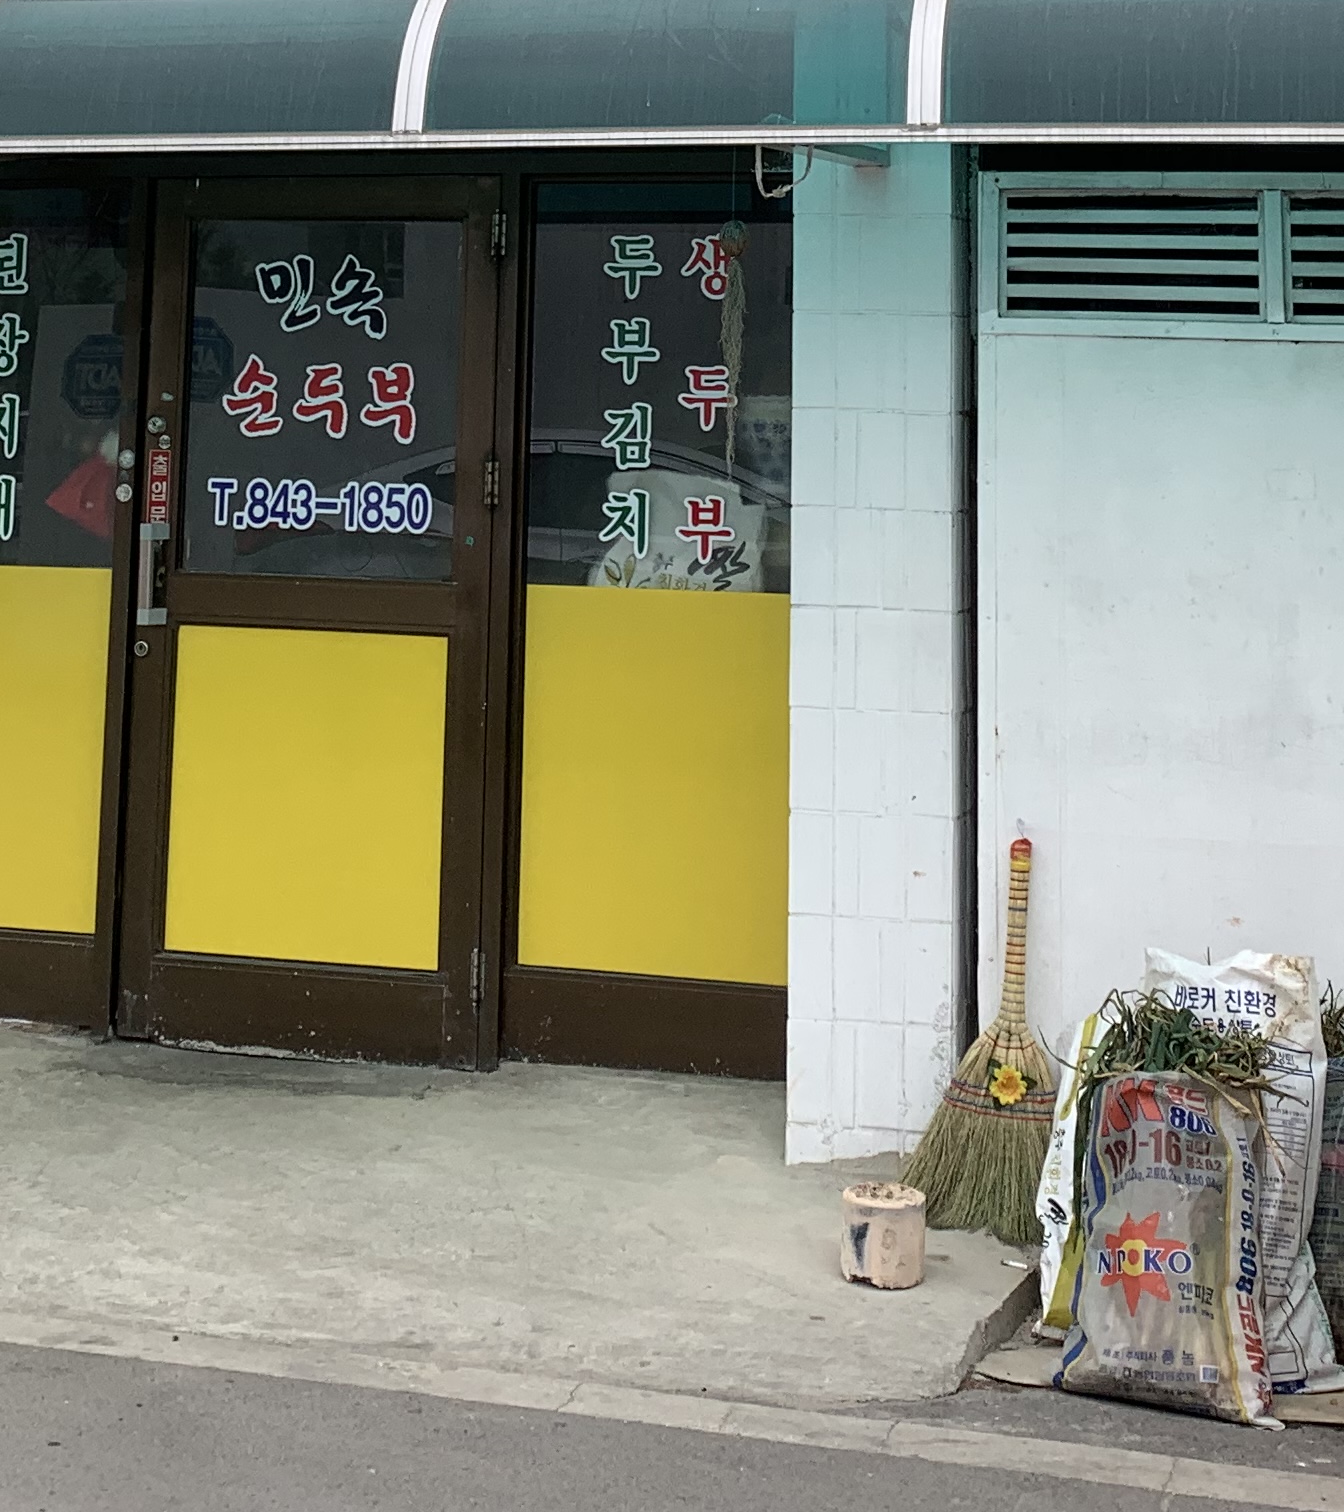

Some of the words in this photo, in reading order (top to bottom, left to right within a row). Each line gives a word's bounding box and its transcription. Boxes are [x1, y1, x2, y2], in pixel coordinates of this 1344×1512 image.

[256, 254, 387, 339] 민속
[222, 354, 417, 445] 순두부
[598, 234, 662, 558] 두부김치
[208, 477, 432, 535] T.843-1850
[1224, 990, 1277, 1017] 친환경
